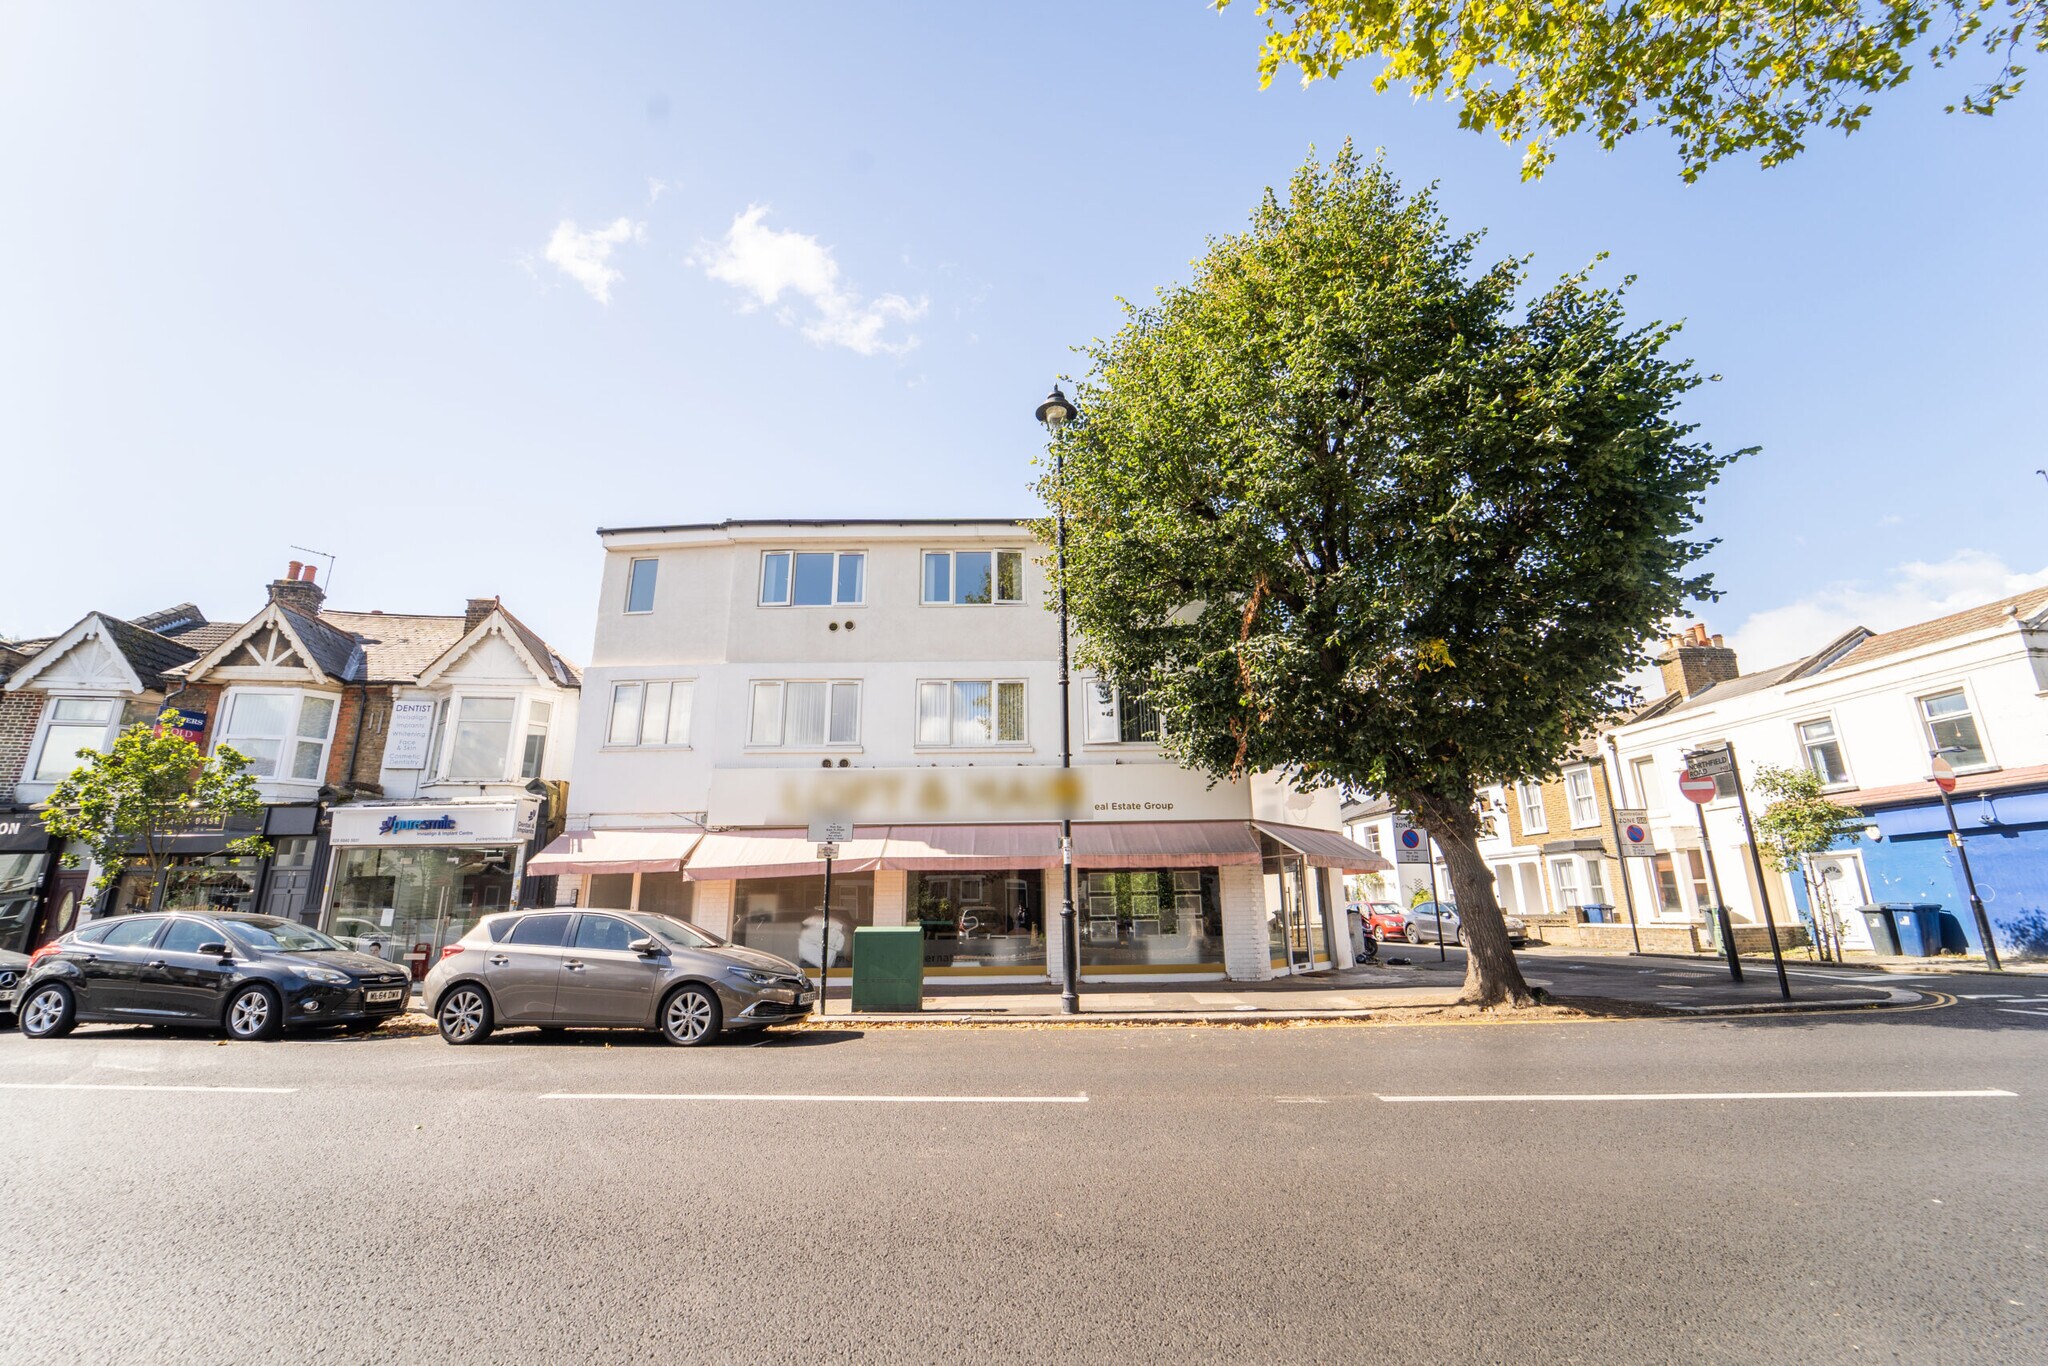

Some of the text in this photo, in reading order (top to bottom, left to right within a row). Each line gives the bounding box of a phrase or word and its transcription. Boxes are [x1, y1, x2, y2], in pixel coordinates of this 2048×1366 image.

[396, 704, 431, 712] DENTIST
[1689, 757, 1727, 770] NORTHFIELD
[1690, 769, 1708, 777] ROAD
[1094, 802, 1174, 811] eal Estate Group
[391, 814, 456, 835] puresmile
